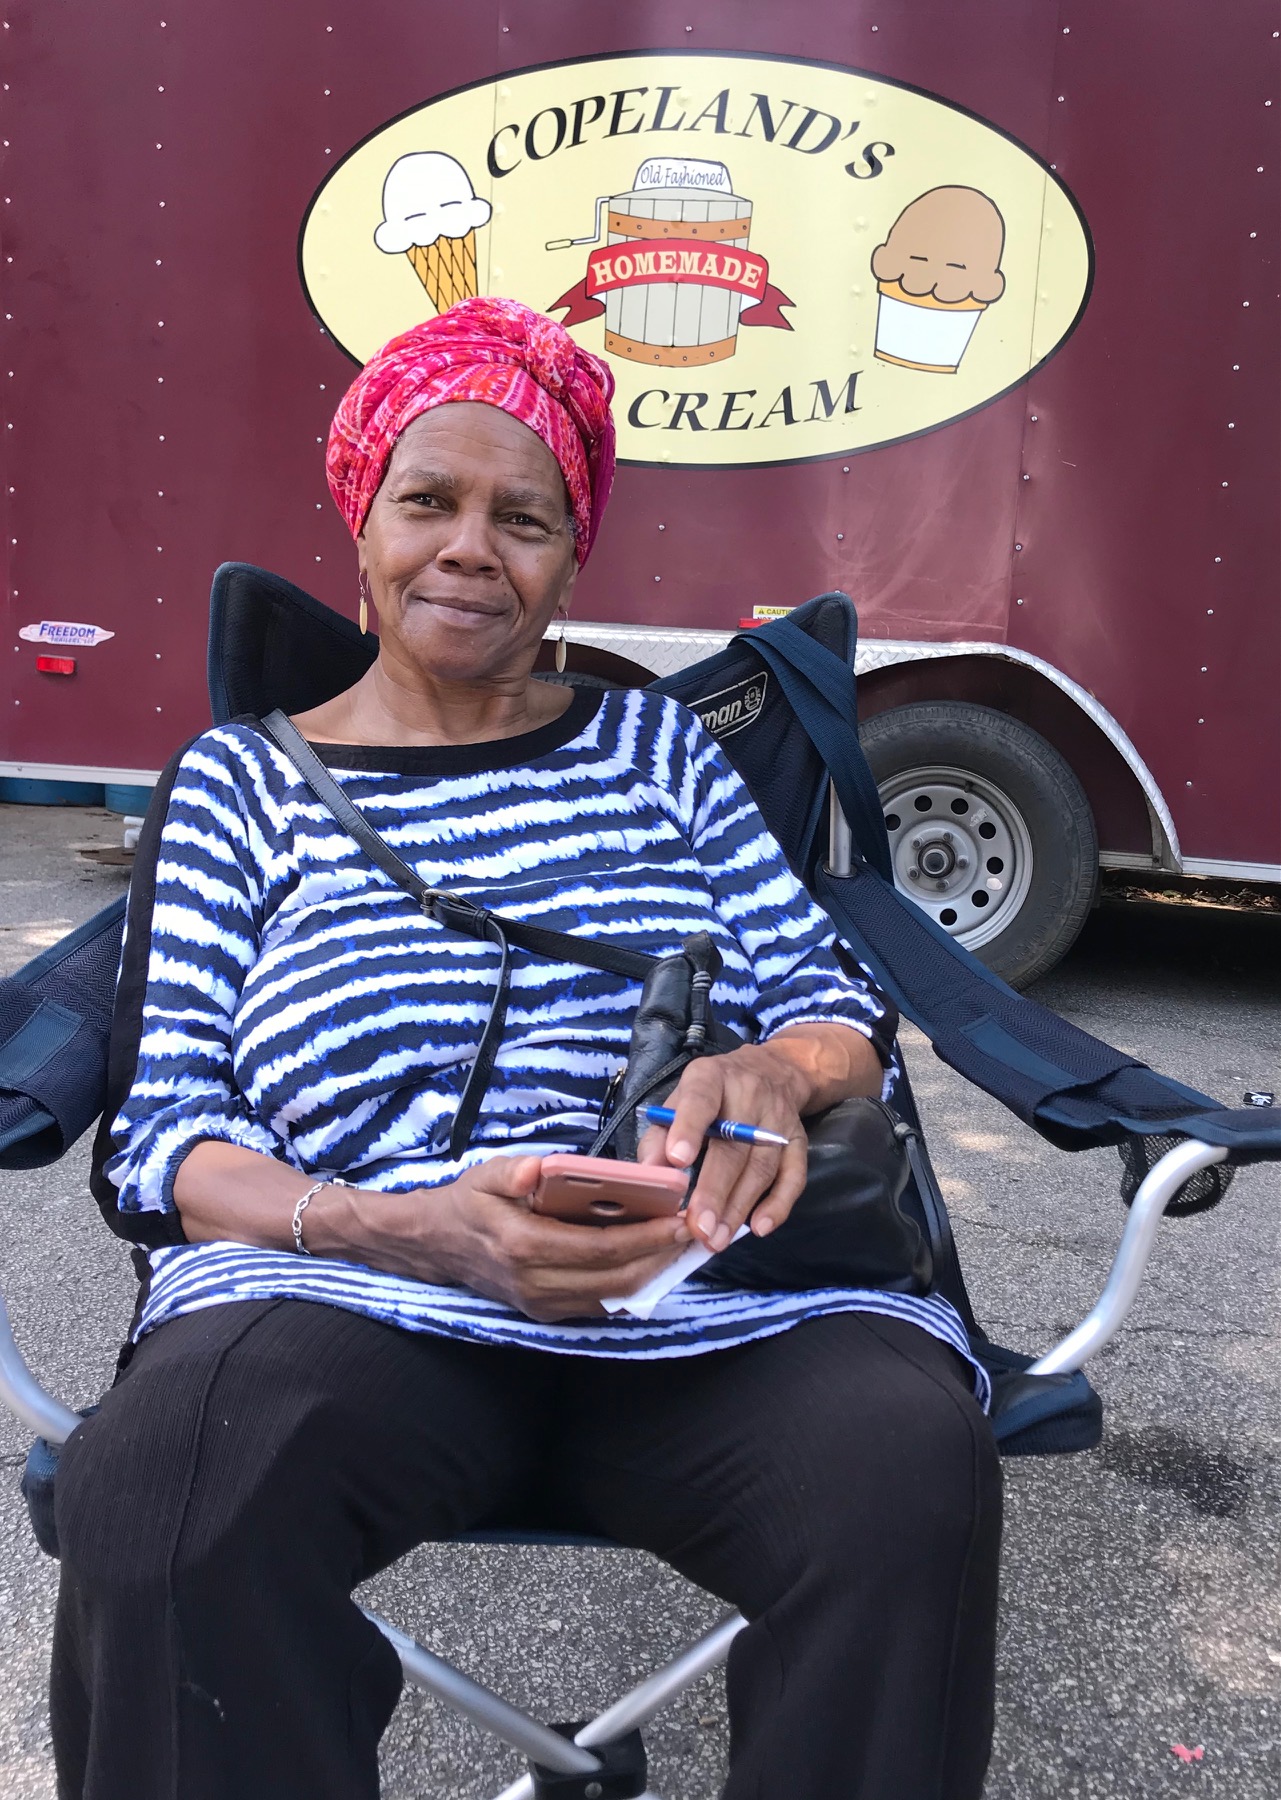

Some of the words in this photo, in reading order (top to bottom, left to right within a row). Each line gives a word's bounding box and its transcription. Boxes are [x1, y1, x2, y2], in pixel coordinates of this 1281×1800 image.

[487, 86, 896, 180] COPELAND'S
[640, 165, 662, 184] Old
[664, 165, 726, 187] Fashioned
[591, 250, 763, 290] HOMEMADE
[627, 370, 864, 432] CREAM
[39, 623, 96, 638] FREEDOM
[700, 699, 742, 729] man
